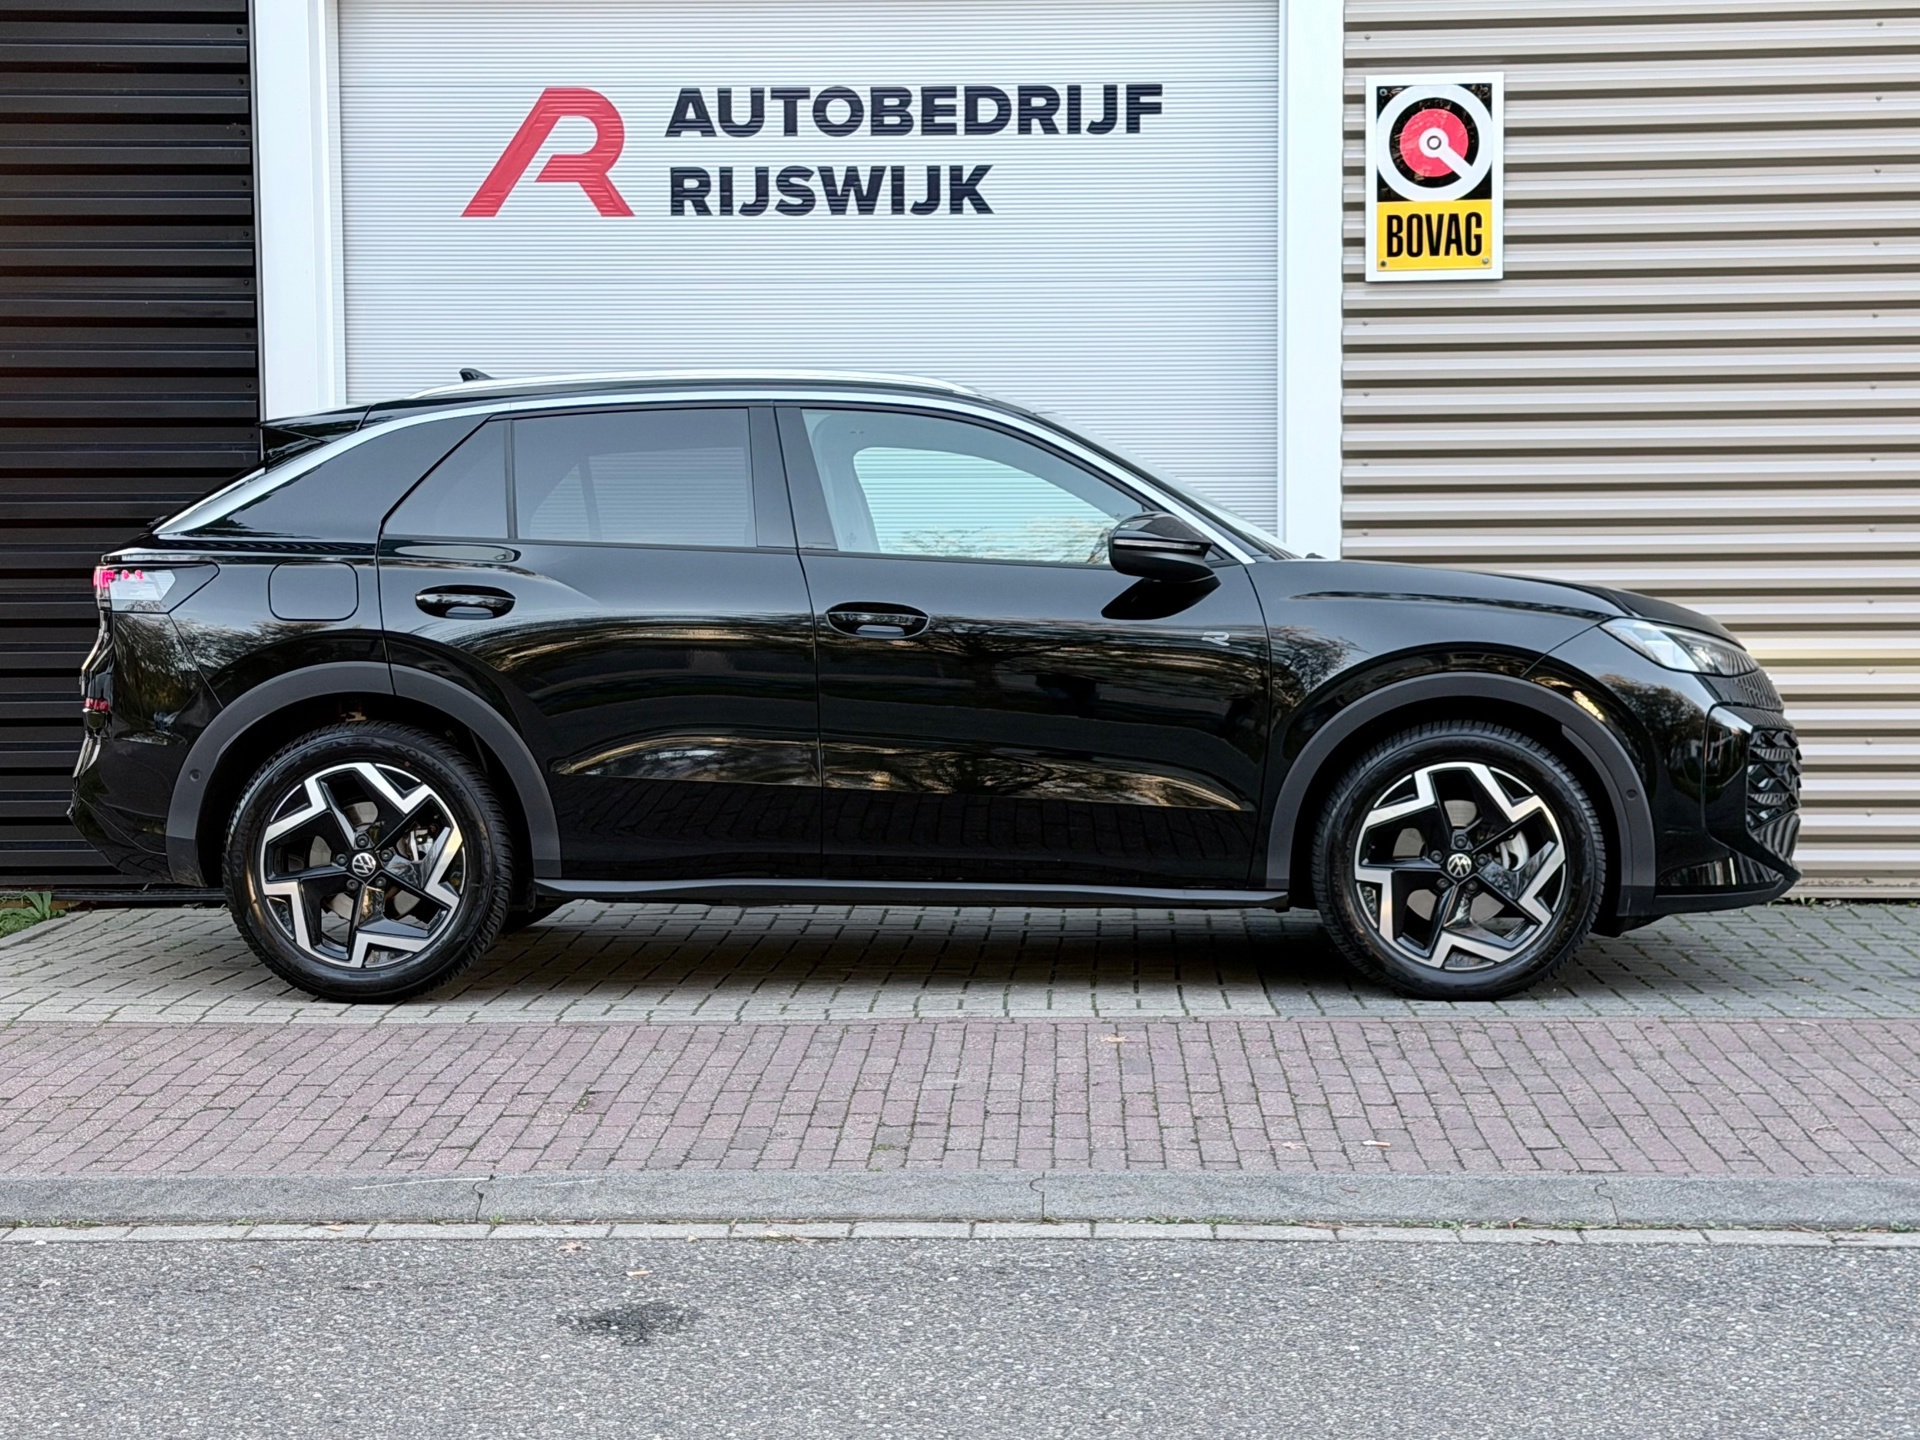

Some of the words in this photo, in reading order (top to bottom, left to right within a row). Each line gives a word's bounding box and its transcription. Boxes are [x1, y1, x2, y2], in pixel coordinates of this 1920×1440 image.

[665, 83, 1163, 138] AUTOBEDRIJF
[669, 164, 995, 217] RIJSWIJK
[1386, 211, 1482, 258] BOVAG
